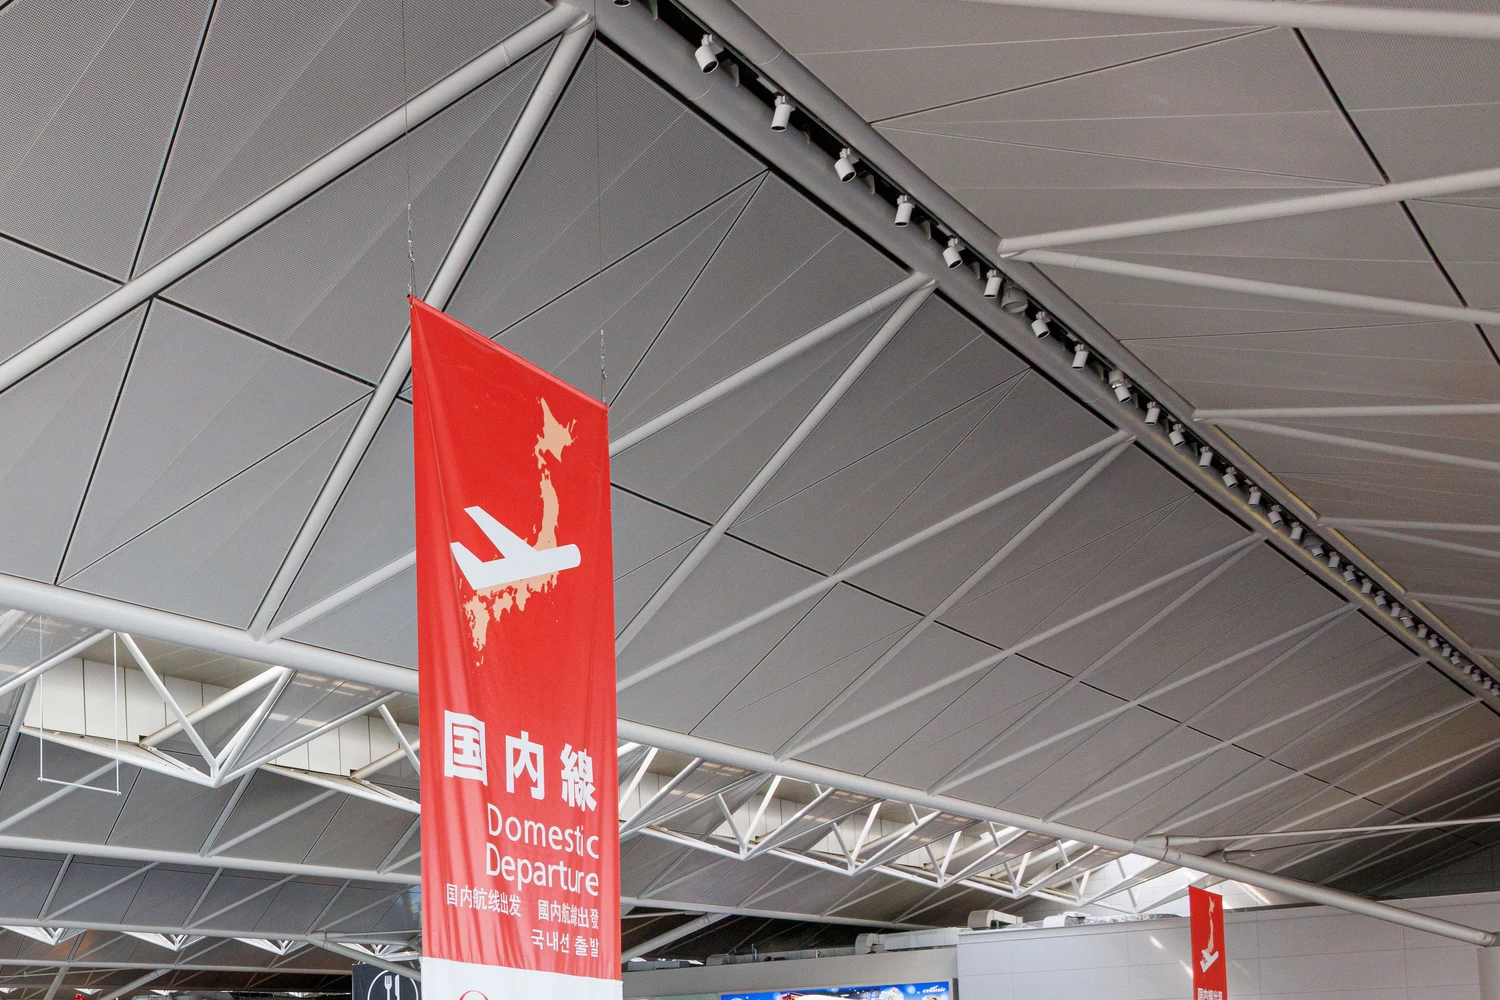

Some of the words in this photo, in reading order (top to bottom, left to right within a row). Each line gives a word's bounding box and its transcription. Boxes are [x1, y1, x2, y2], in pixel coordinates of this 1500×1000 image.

[444, 709, 597, 812] 国内線
[487, 802, 600, 859] Domestic
[485, 841, 599, 897] Departure
[446, 882, 522, 917] 国内航线出发
[531, 928, 570, 954] 국내선
[574, 934, 600, 958] 출발
